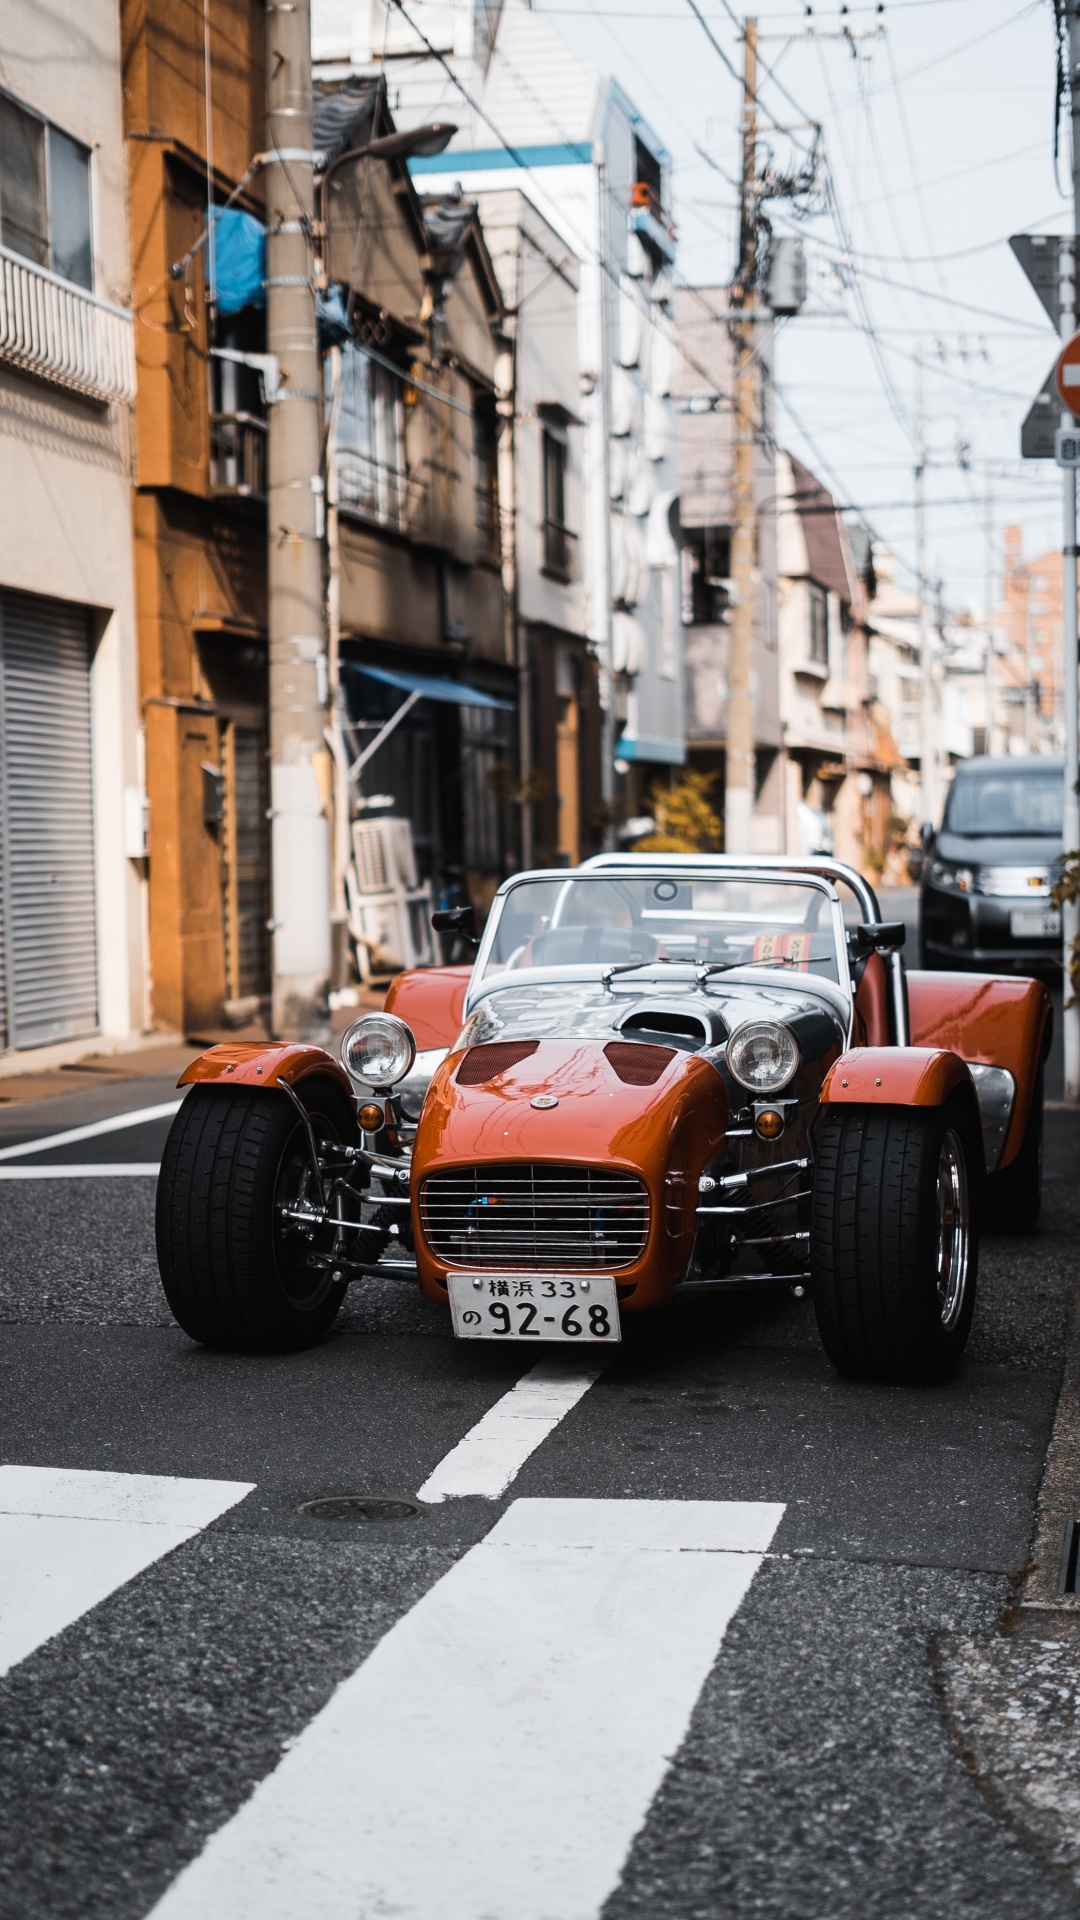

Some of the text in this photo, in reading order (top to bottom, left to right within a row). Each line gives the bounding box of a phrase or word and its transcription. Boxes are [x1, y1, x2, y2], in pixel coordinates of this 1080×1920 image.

[488, 1279, 576, 1298] 横浜 33
[462, 1302, 611, 1337] の 92-68
